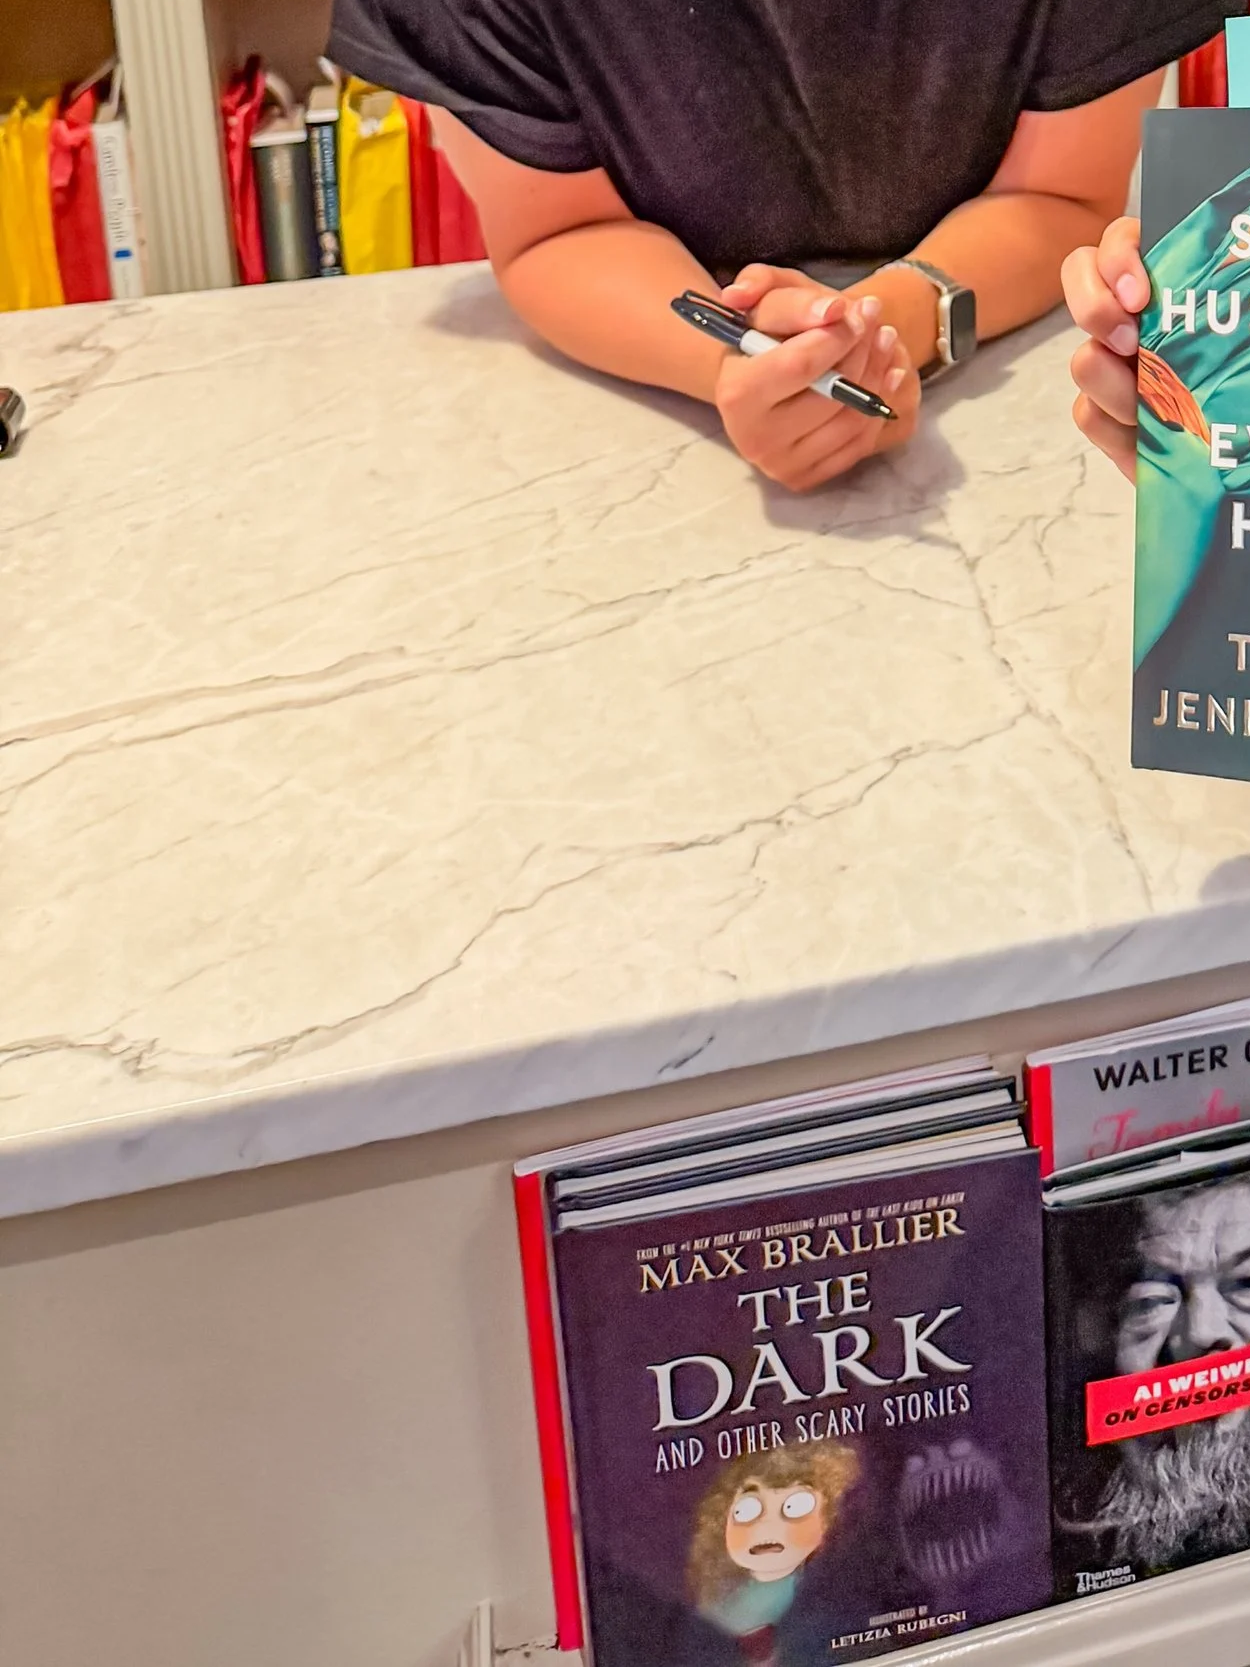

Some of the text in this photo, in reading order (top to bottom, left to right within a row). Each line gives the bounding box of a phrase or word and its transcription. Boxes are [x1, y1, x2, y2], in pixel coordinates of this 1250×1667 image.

[1093, 1045, 1229, 1092] WALTER
[639, 1208, 967, 1293] MAX BRALLIER
[737, 1272, 873, 1333] THE
[646, 1306, 975, 1432] DARK
[1135, 1381, 1162, 1402] AI
[656, 1384, 972, 1474] AND OTHER SCARY STORIES
[1105, 1403, 1141, 1426] ON
[1075, 1565, 1131, 1584] Thames
[831, 1610, 967, 1649] LETIZIA RUBEGNI
